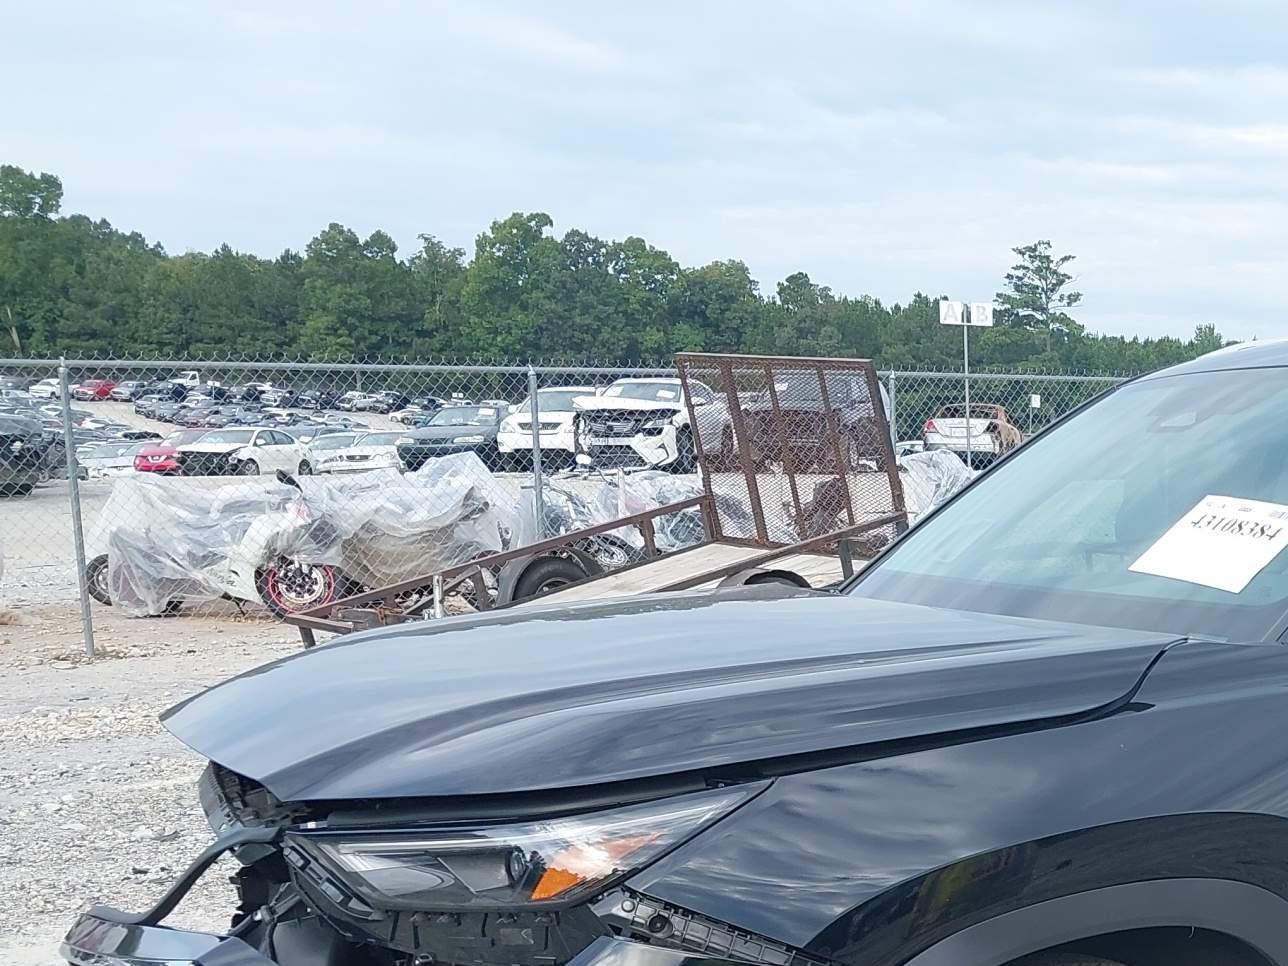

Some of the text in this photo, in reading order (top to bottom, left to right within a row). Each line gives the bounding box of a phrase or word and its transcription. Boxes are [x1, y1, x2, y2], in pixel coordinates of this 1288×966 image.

[943, 303, 958, 322] A
[975, 305, 989, 323] B
[1191, 514, 1283, 541] 43108384
